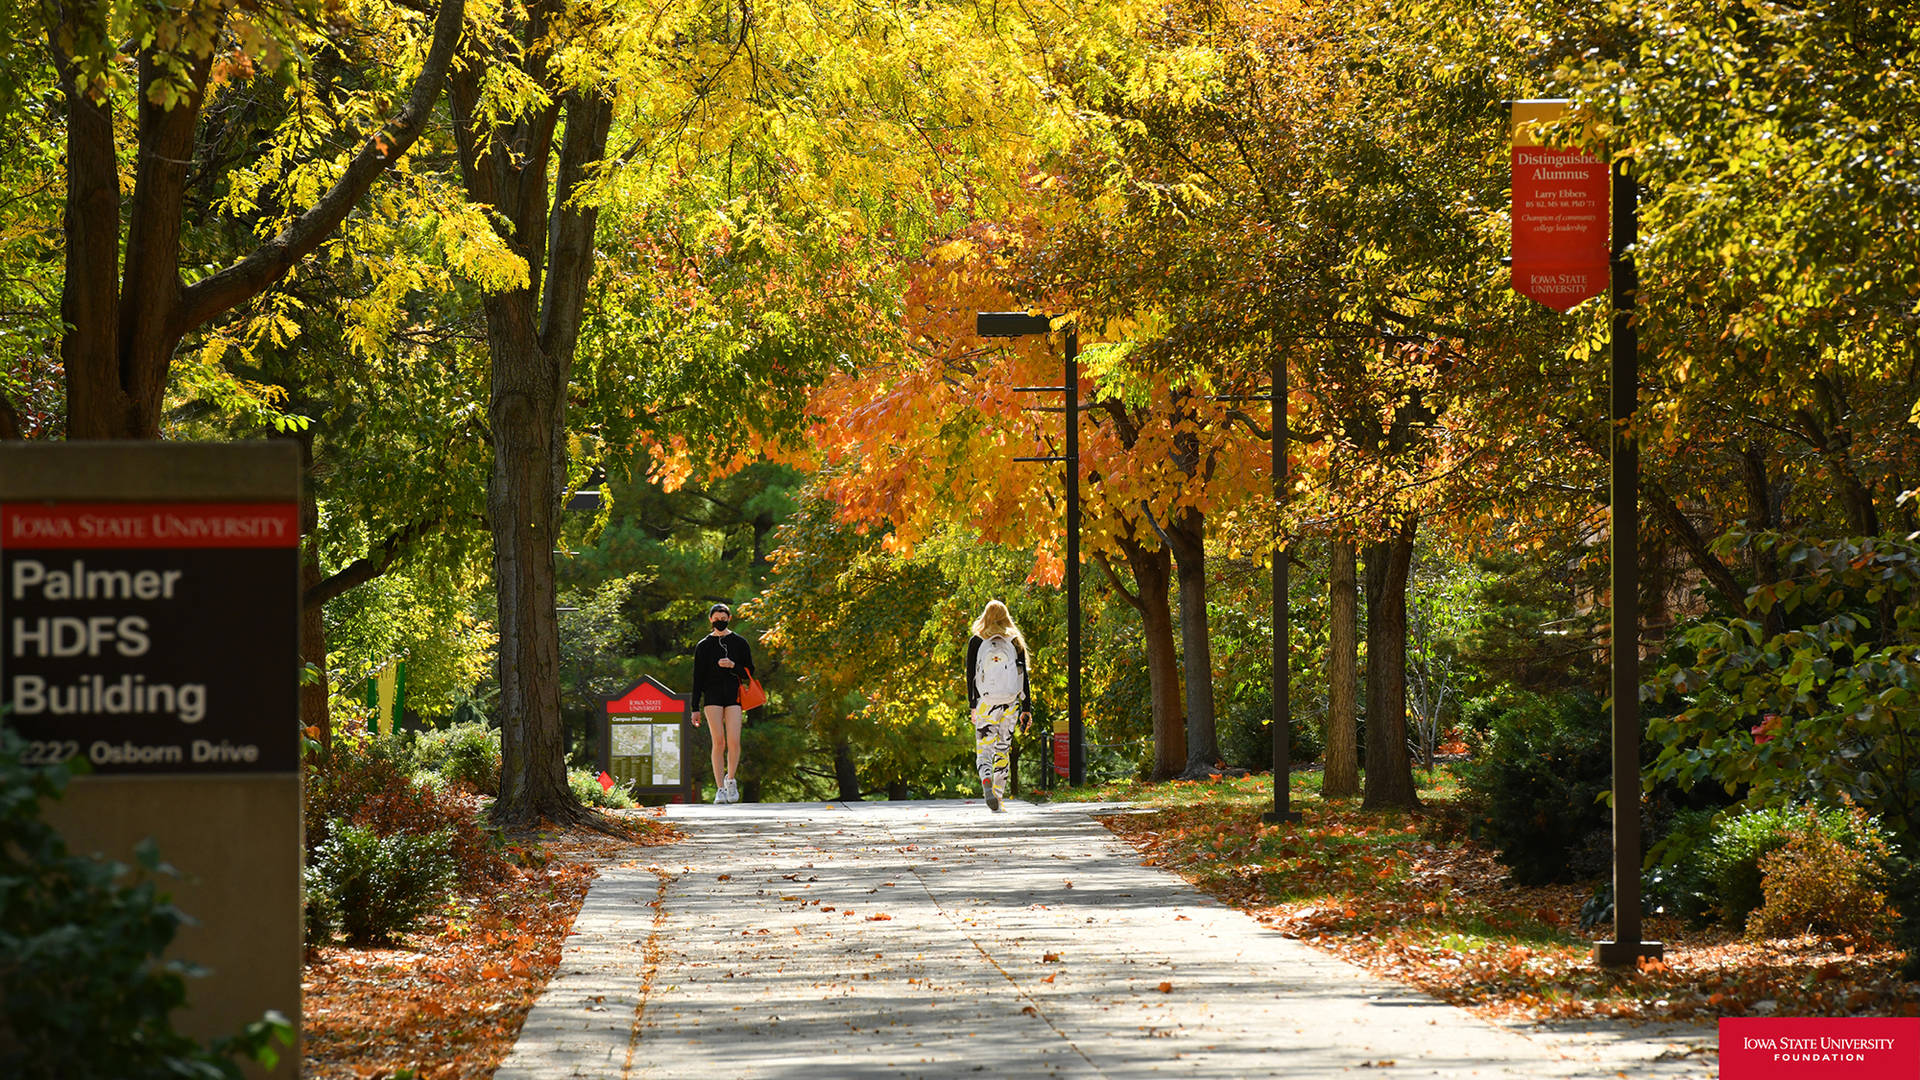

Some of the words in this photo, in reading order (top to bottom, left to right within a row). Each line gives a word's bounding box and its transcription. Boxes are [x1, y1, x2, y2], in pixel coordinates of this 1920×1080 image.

[1532, 168, 1589, 180] Alumnus
[1535, 190, 1557, 200] Larry
[1559, 189, 1587, 198] Ebbers
[1521, 214, 1554, 223] Champion
[1534, 224, 1554, 233] college
[1556, 224, 1588, 233] leadership
[1531, 274, 1557, 284] IOWA
[1558, 274, 1587, 284] STATE
[1531, 285, 1586, 294] UNIVERSITY
[11, 515, 74, 539] IOWA
[78, 514, 147, 539] STATE
[152, 514, 287, 539] UNIVERSITY
[12, 559, 182, 600] Palmer
[12, 616, 150, 657] HDFS
[12, 674, 207, 724] Building
[89, 741, 183, 764] Osborn
[192, 739, 260, 763] Drive
